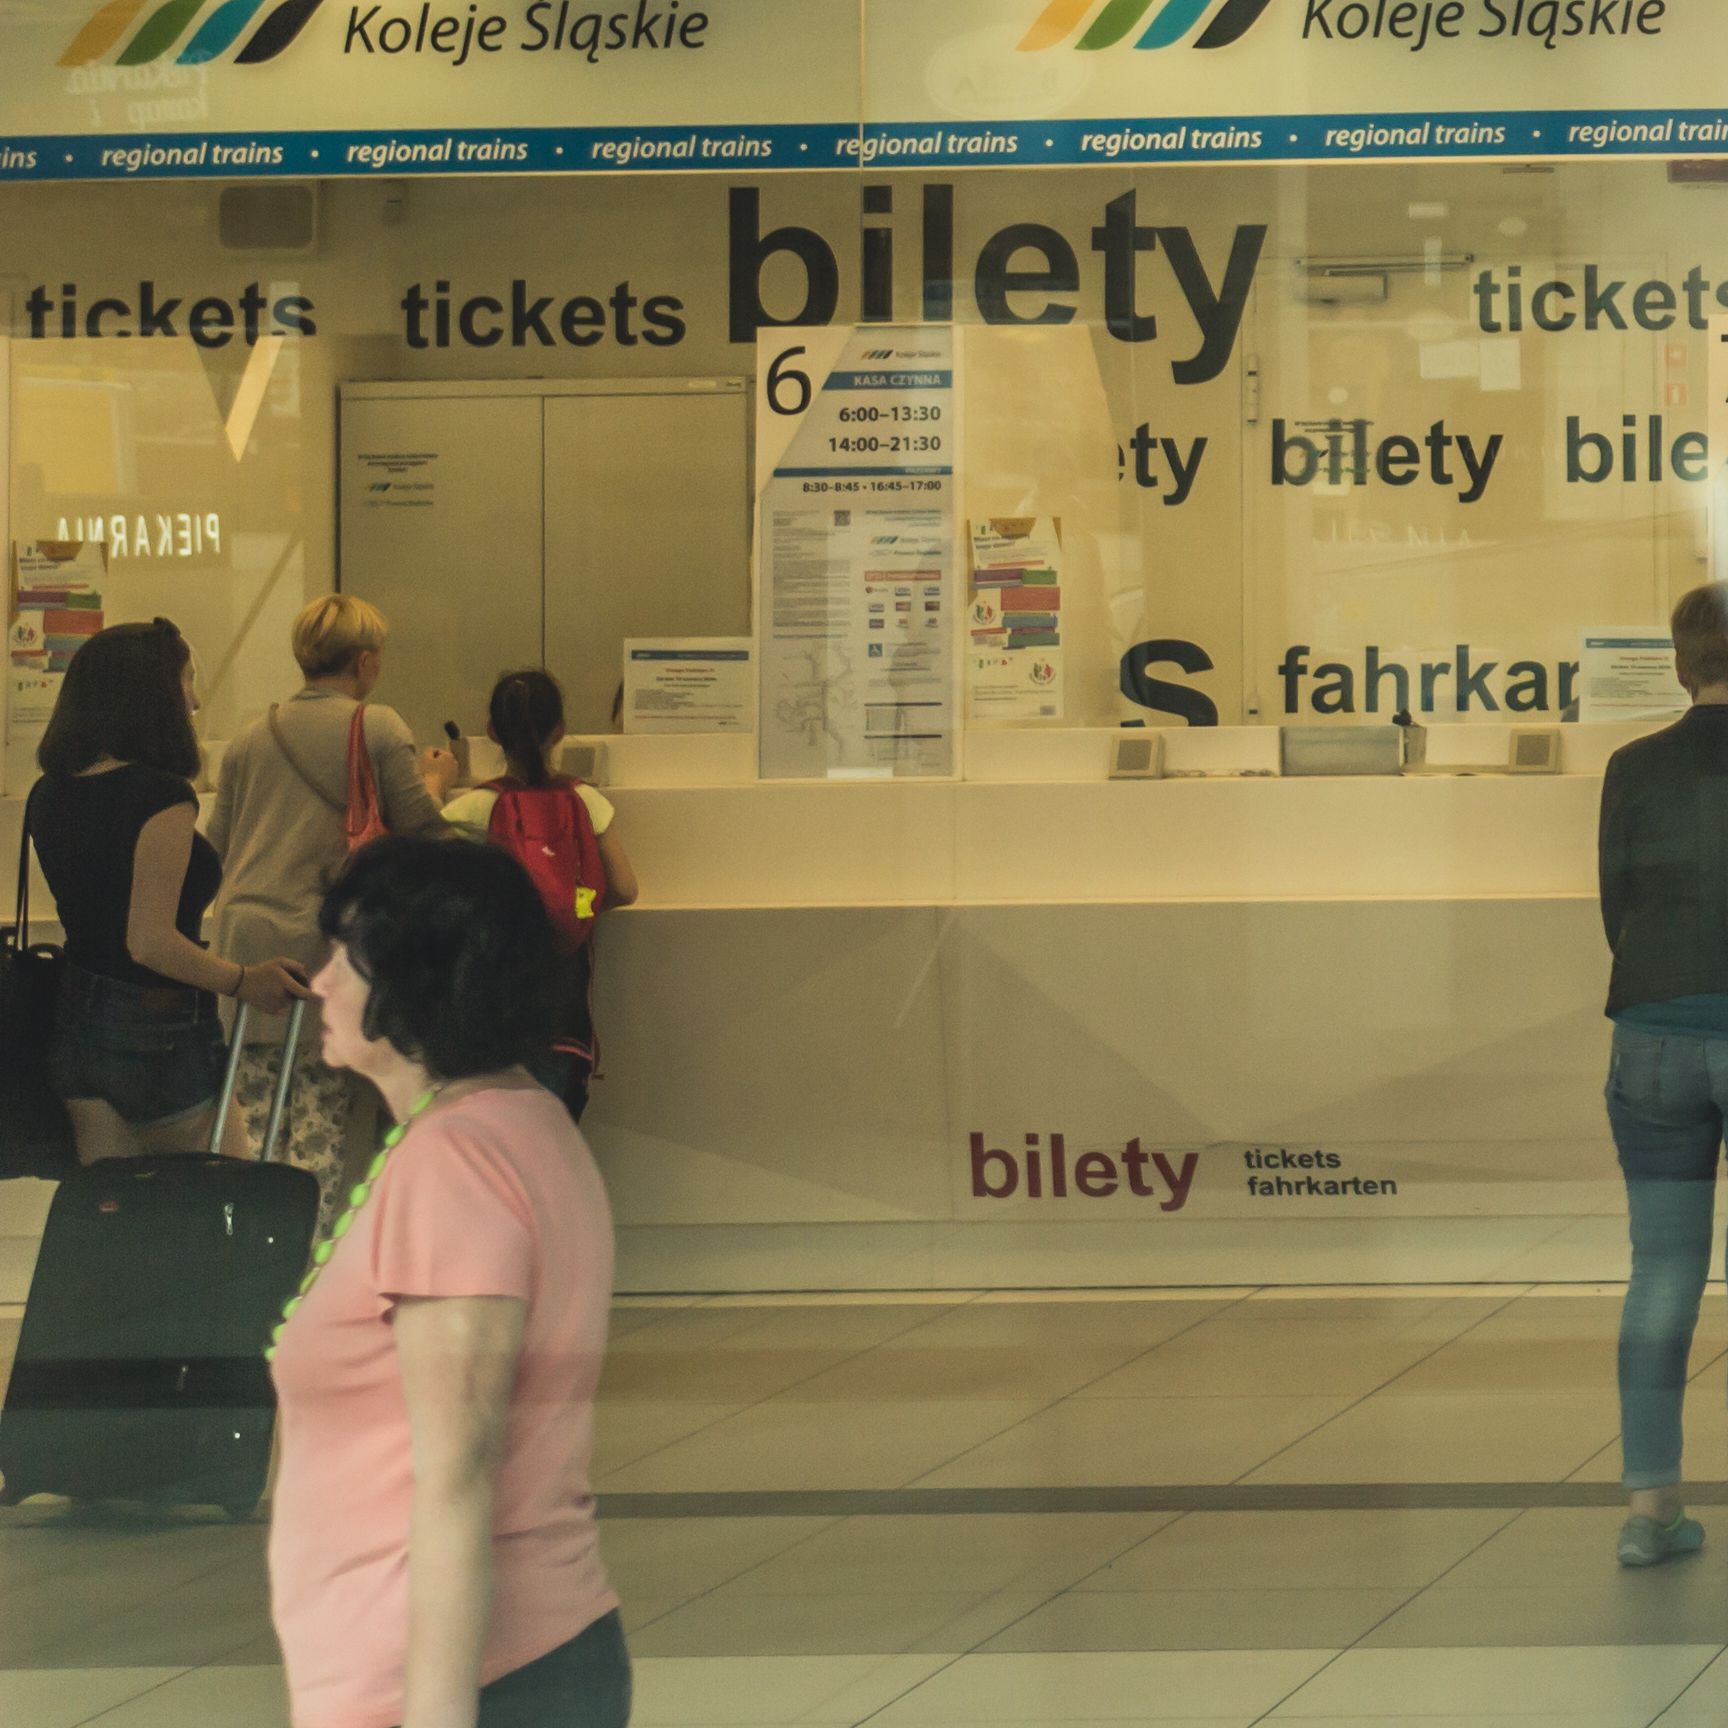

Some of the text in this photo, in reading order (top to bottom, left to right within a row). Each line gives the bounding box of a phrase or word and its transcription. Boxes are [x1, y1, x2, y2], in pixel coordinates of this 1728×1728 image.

[344, 2, 507, 66] Koleje
[590, 133, 772, 169] regional trains
[835, 130, 1018, 165] regional trains
[1080, 126, 1262, 160] regional trains
[1324, 122, 1505, 156] regional trains
[1568, 118, 1673, 153] regional
[0, 145, 37, 169] ins
[101, 140, 283, 176] regional trains
[346, 136, 528, 172] regional trains
[728, 184, 1267, 385] bilety
[27, 280, 316, 348] tickets
[401, 280, 686, 348] tickets
[767, 345, 811, 415] 6
[854, 373, 941, 385] KASA CZYNNA
[1117, 422, 1208, 506] ty
[1272, 418, 1504, 503] bilety
[1278, 645, 1579, 715] fahrkar
[969, 1132, 1199, 1212] bilety
[1244, 1149, 1341, 1169] tickets
[1248, 1175, 1398, 1196] fahrkarten
